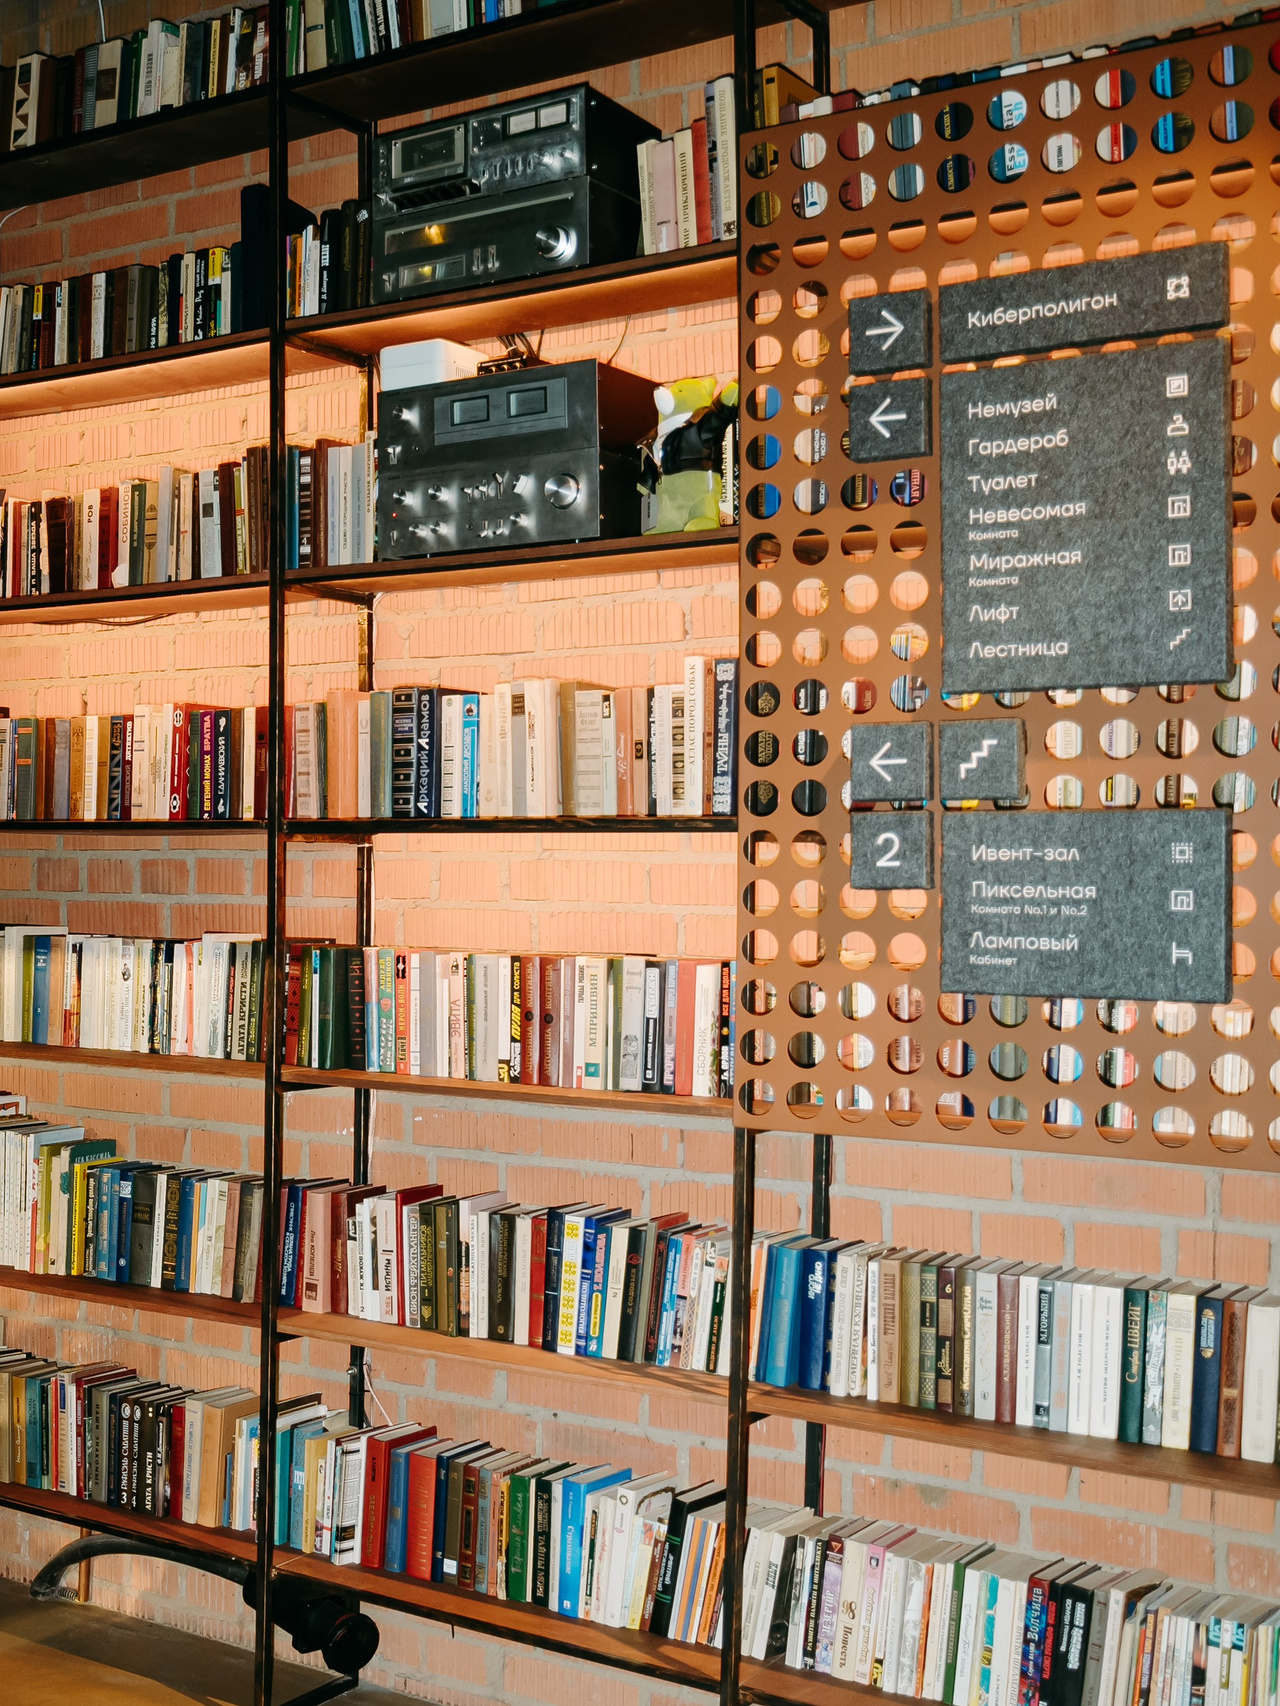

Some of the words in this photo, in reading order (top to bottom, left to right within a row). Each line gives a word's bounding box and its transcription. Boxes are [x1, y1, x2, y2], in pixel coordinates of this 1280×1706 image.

[718, 89, 727, 136] ПОЗНАНИЕ
[679, 152, 690, 223] ПРИКЛЮЧЕНИЙ
[720, 139, 732, 212] ПРОДОЛЖАЕТСЯ
[967, 292, 1118, 329] Киберполигон
[967, 392, 1058, 420] Немузей
[968, 429, 1069, 457] Гардероб
[968, 474, 1039, 496] Туалет
[122, 486, 131, 544] СОБИНОВ
[969, 501, 1087, 525] Невесомая
[969, 528, 1019, 541] Комната
[969, 550, 1082, 572] Миражная
[969, 575, 1019, 588] Комната
[969, 603, 1020, 624] Лифт
[969, 641, 1069, 659] Лестница
[688, 663, 697, 697] СОБАК
[418, 694, 431, 750] Адамов
[688, 698, 697, 733] ПОРОД
[125, 720, 133, 761] ДЕТЕКТИВ
[203, 715, 212, 752] БРАТВА
[688, 735, 696, 766] АТЛАС
[204, 754, 212, 779] МОНАХ
[716, 732, 729, 774] ТАЙНЫ
[203, 780, 212, 811] ЕВГЕНИЙ
[417, 750, 430, 814] Аркадий
[876, 832, 901, 868] 2
[971, 844, 1080, 862] Ивент-зал
[972, 880, 1097, 900] Пиксельная
[970, 903, 1021, 915] Комната
[1024, 903, 1048, 915] No.1
[1050, 906, 1058, 915] и
[1061, 904, 1087, 916] No.2
[970, 931, 1079, 951] Ламповый
[970, 953, 1018, 966] Кабинет
[238, 981, 247, 1022] КРИСТИ
[513, 991, 521, 1004] для
[525, 962, 533, 1008] КОПТЯЕВА
[545, 964, 553, 1010] КОПТЯЕВА
[646, 972, 657, 1017] ЦЫГАН
[721, 989, 729, 1003] ДЛЯ
[450, 998, 461, 1038] ЭВИТА
[511, 1004, 521, 1040] ПУЛЯ
[588, 973, 598, 1048] М.ПРИШВИН
[721, 1003, 729, 1017] ВСЕ
[237, 1023, 246, 1056] АГАТА
[525, 1026, 533, 1074] АНТОНИНА
[544, 1028, 552, 1077] АНТОНИНА
[696, 1027, 707, 1076] СБОРНИК
[663, 1043, 674, 1086] ПРОРОК
[721, 1045, 729, 1070] ОРЛОВ
[408, 1217, 418, 1286] ФЕЙХТВАНГЕР
[595, 1232, 607, 1283] ПОЛЯКОВА
[383, 1258, 392, 1292] ИСТИНЫ
[808, 1274, 816, 1300] ИНОГО
[814, 1261, 824, 1283] ДАНО
[814, 1282, 822, 1294] НЕ
[408, 1286, 418, 1315] ЛИОН
[578, 1281, 589, 1334] ПОЛИТОЛОГИЯ
[961, 1285, 972, 1340] СИМОНОВ
[1038, 1292, 1049, 1342] М.ГОРЬКИЙ
[882, 1303, 896, 1337] ТУРЕЦКИЙ
[1126, 1302, 1142, 1349] ЦВЕЙГ
[850, 1328, 860, 1391] СЕМЕЙНАЯ
[959, 1340, 971, 1391] Константин
[1125, 1349, 1140, 1384] Стефан
[1039, 1407, 1045, 1415] 5
[121, 1420, 130, 1457] САБАТИНИ
[121, 1457, 129, 1491] РАФАЭЛЬ
[145, 1451, 153, 1485] КРИСТИ
[145, 1487, 153, 1511] АГАТА
[536, 1534, 547, 1569] ТАЙНЫ
[564, 1525, 575, 1575] Страхование
[811, 1541, 823, 1584] ИНТЕЛЛЕКТА
[535, 1570, 546, 1598] МОРЯ
[808, 1591, 819, 1618] ПАМЯТИ
[821, 1589, 835, 1635] ДЕЗЕРТИР
[1026, 1586, 1043, 1642] Волчица
[806, 1618, 816, 1652] РАЗВИТИЕ
[839, 1625, 853, 1669] Повесть
